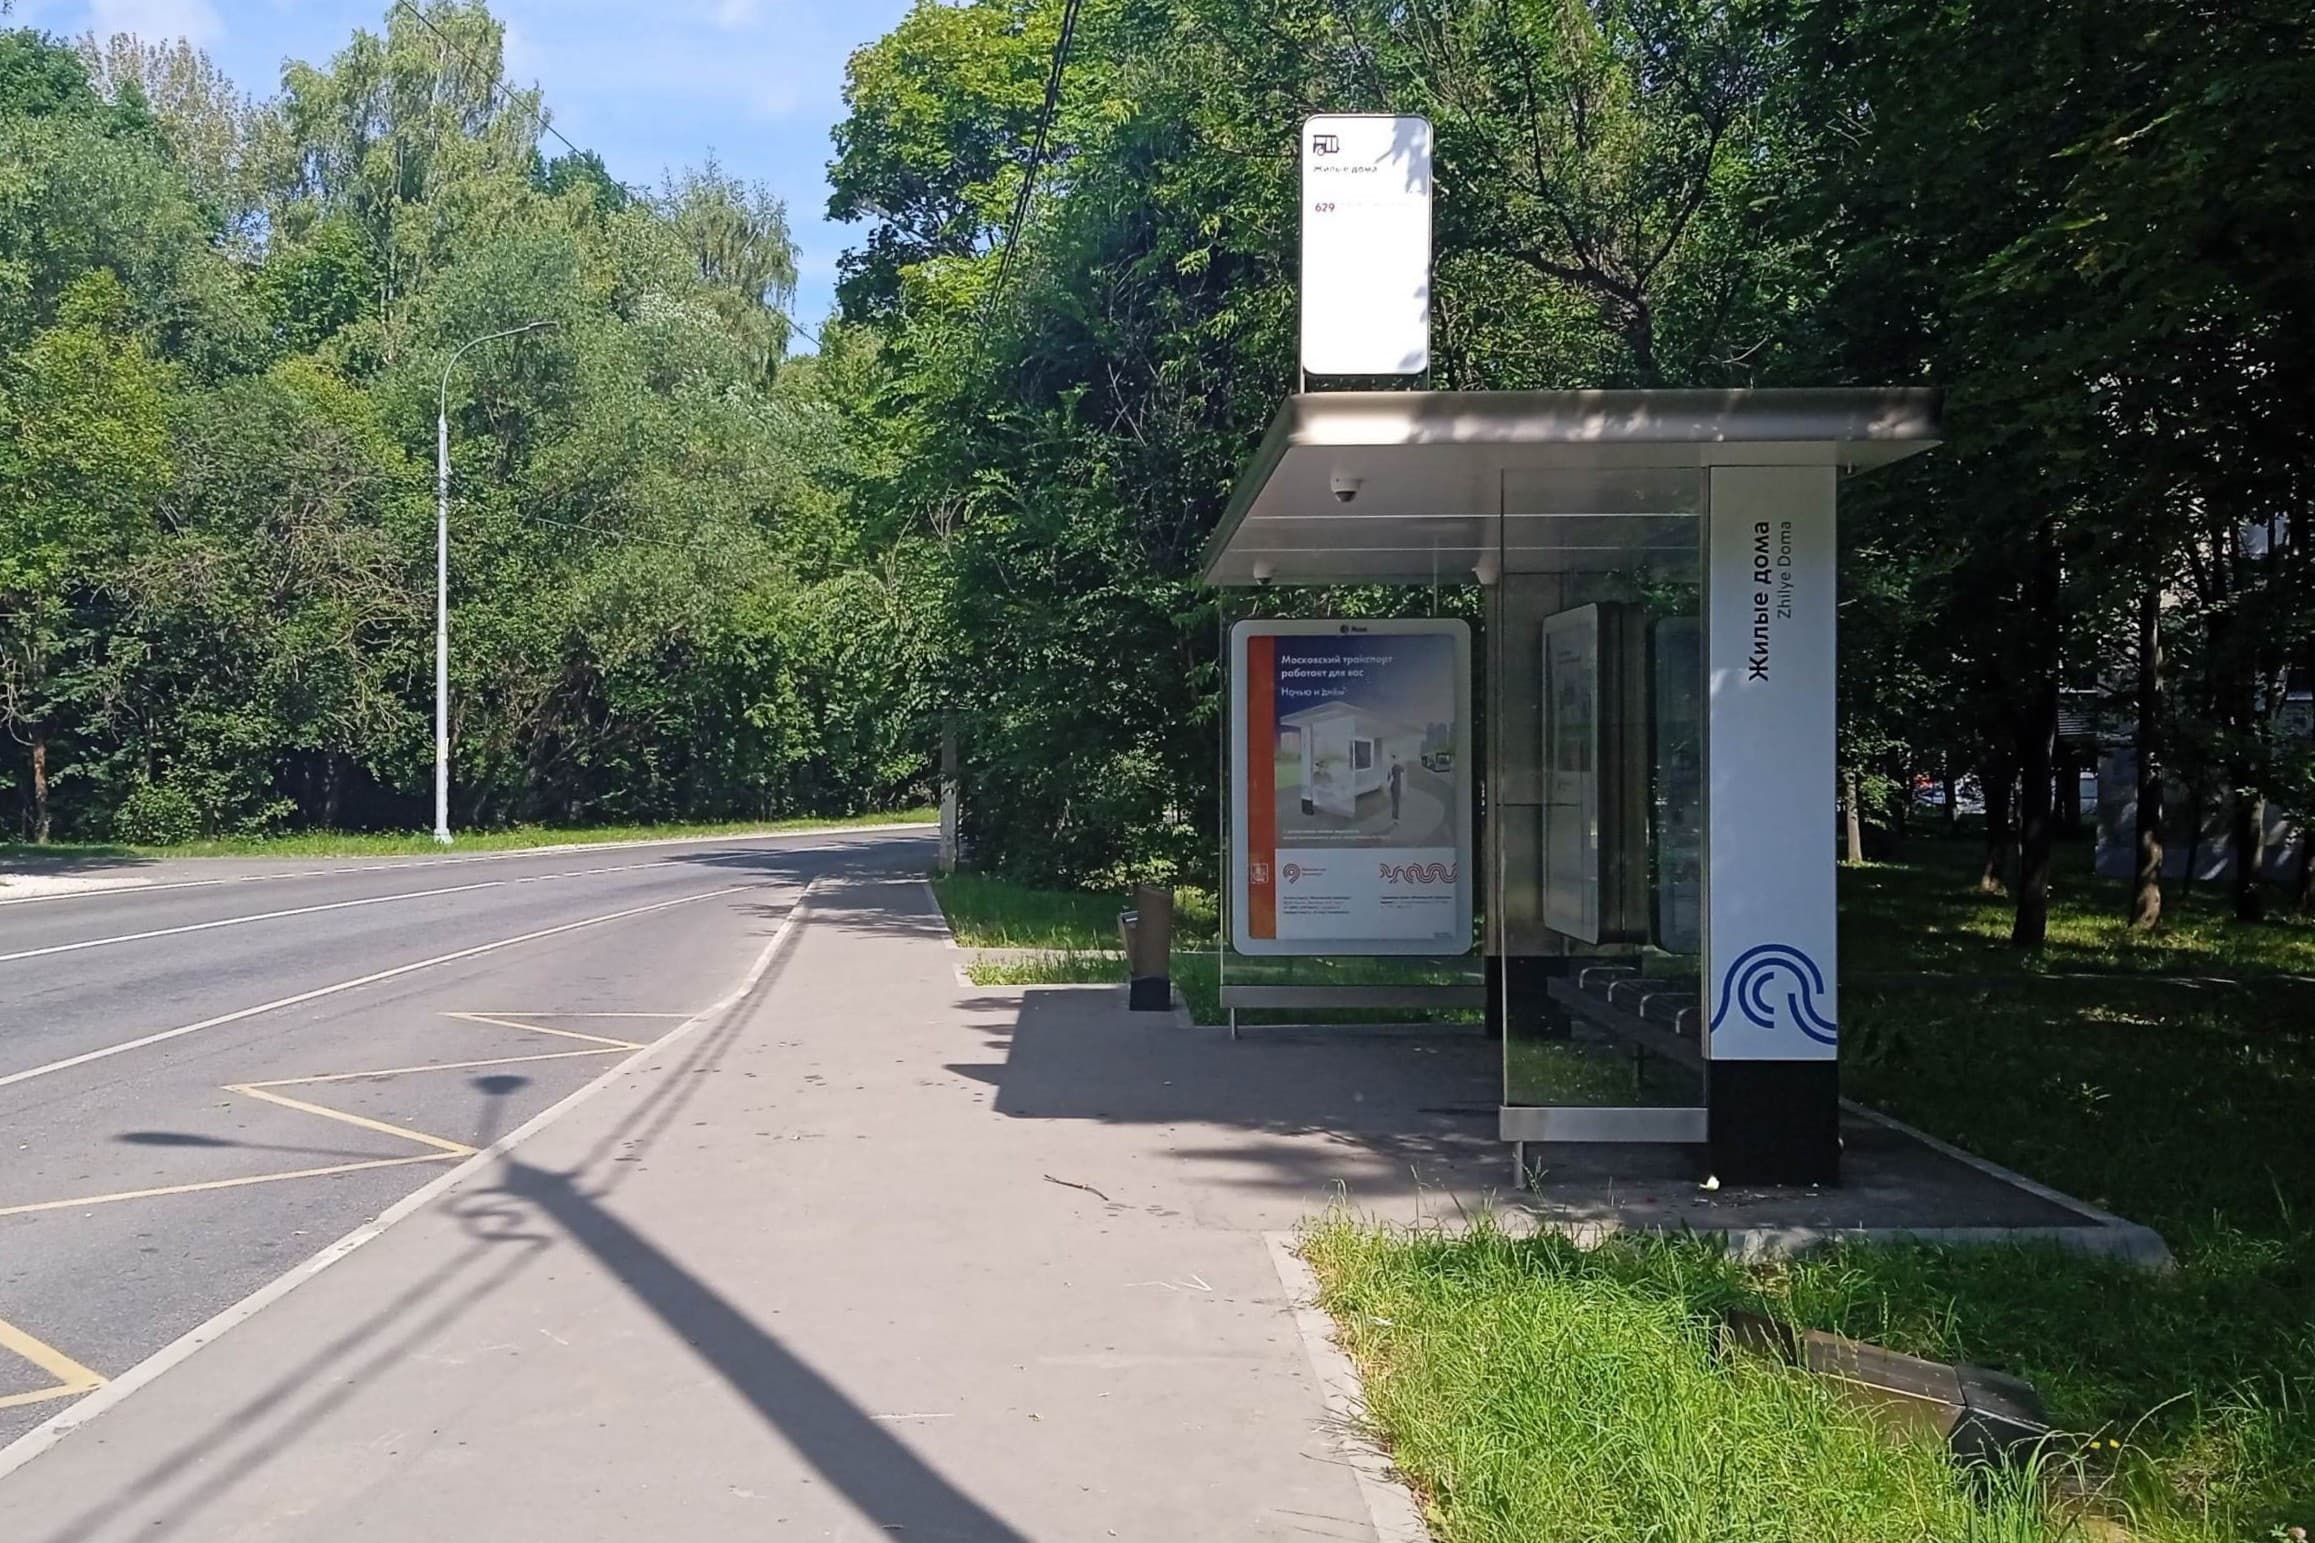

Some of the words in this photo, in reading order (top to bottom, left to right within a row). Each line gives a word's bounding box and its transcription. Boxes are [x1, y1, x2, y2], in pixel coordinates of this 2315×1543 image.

[1315, 203, 1335, 212] 629
[1754, 521, 1771, 585] дома
[1777, 521, 1792, 567] Doma
[1777, 572, 1794, 619] Zhilye
[1749, 592, 1769, 682] Жилые
[1281, 655, 1341, 664] Московский
[1343, 656, 1393, 666] транспорт
[1281, 668, 1326, 679] работает
[1328, 669, 1346, 678] для
[1348, 669, 1364, 677] вас
[1281, 687, 1312, 697] Ночью
